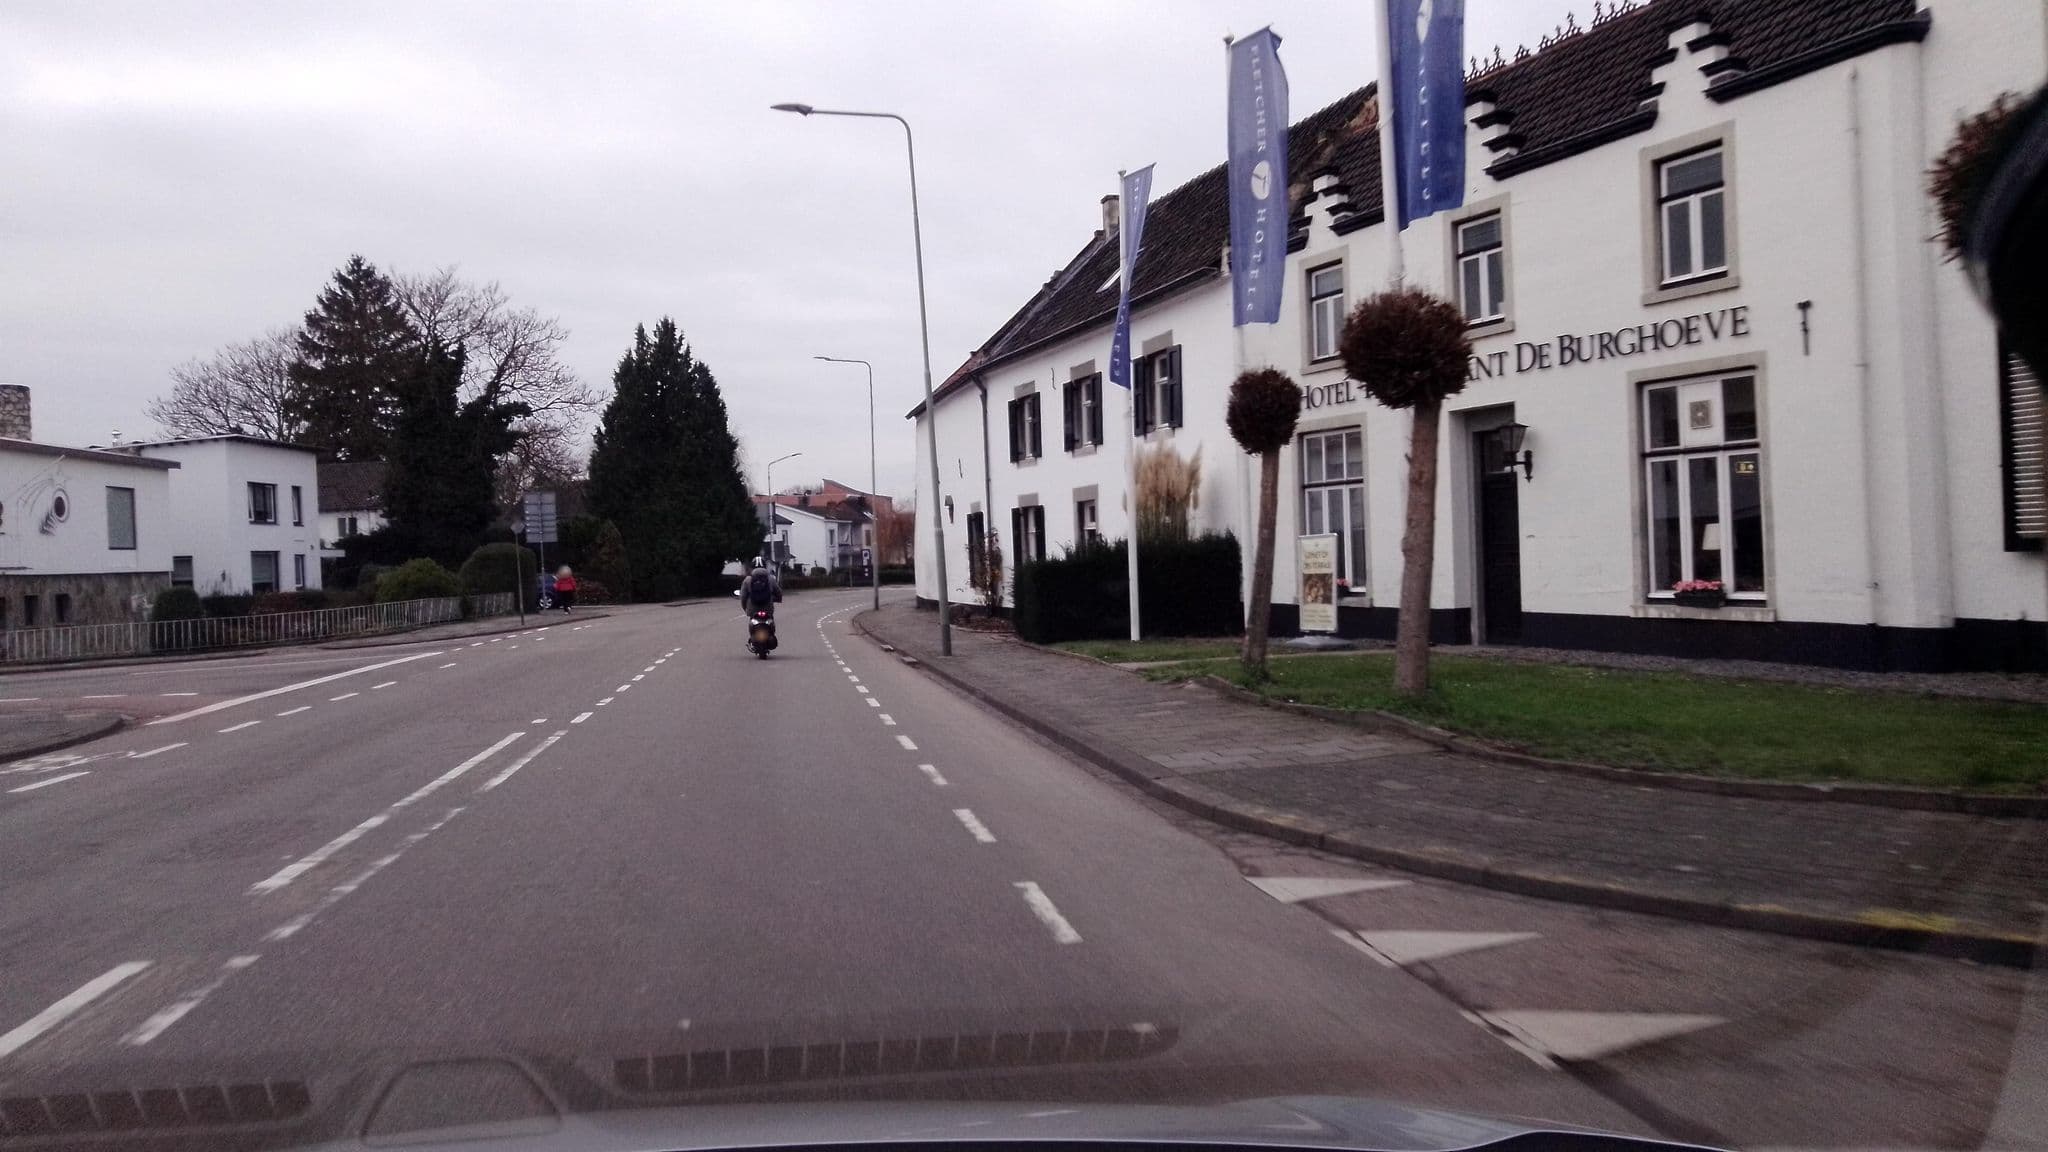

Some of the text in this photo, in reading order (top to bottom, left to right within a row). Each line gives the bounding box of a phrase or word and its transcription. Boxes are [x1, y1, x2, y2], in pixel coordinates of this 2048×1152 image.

[1249, 44, 1267, 153] FLETCHER
[1301, 380, 1355, 410] HOTEL
[1558, 305, 1750, 366] BURGHOEVE
